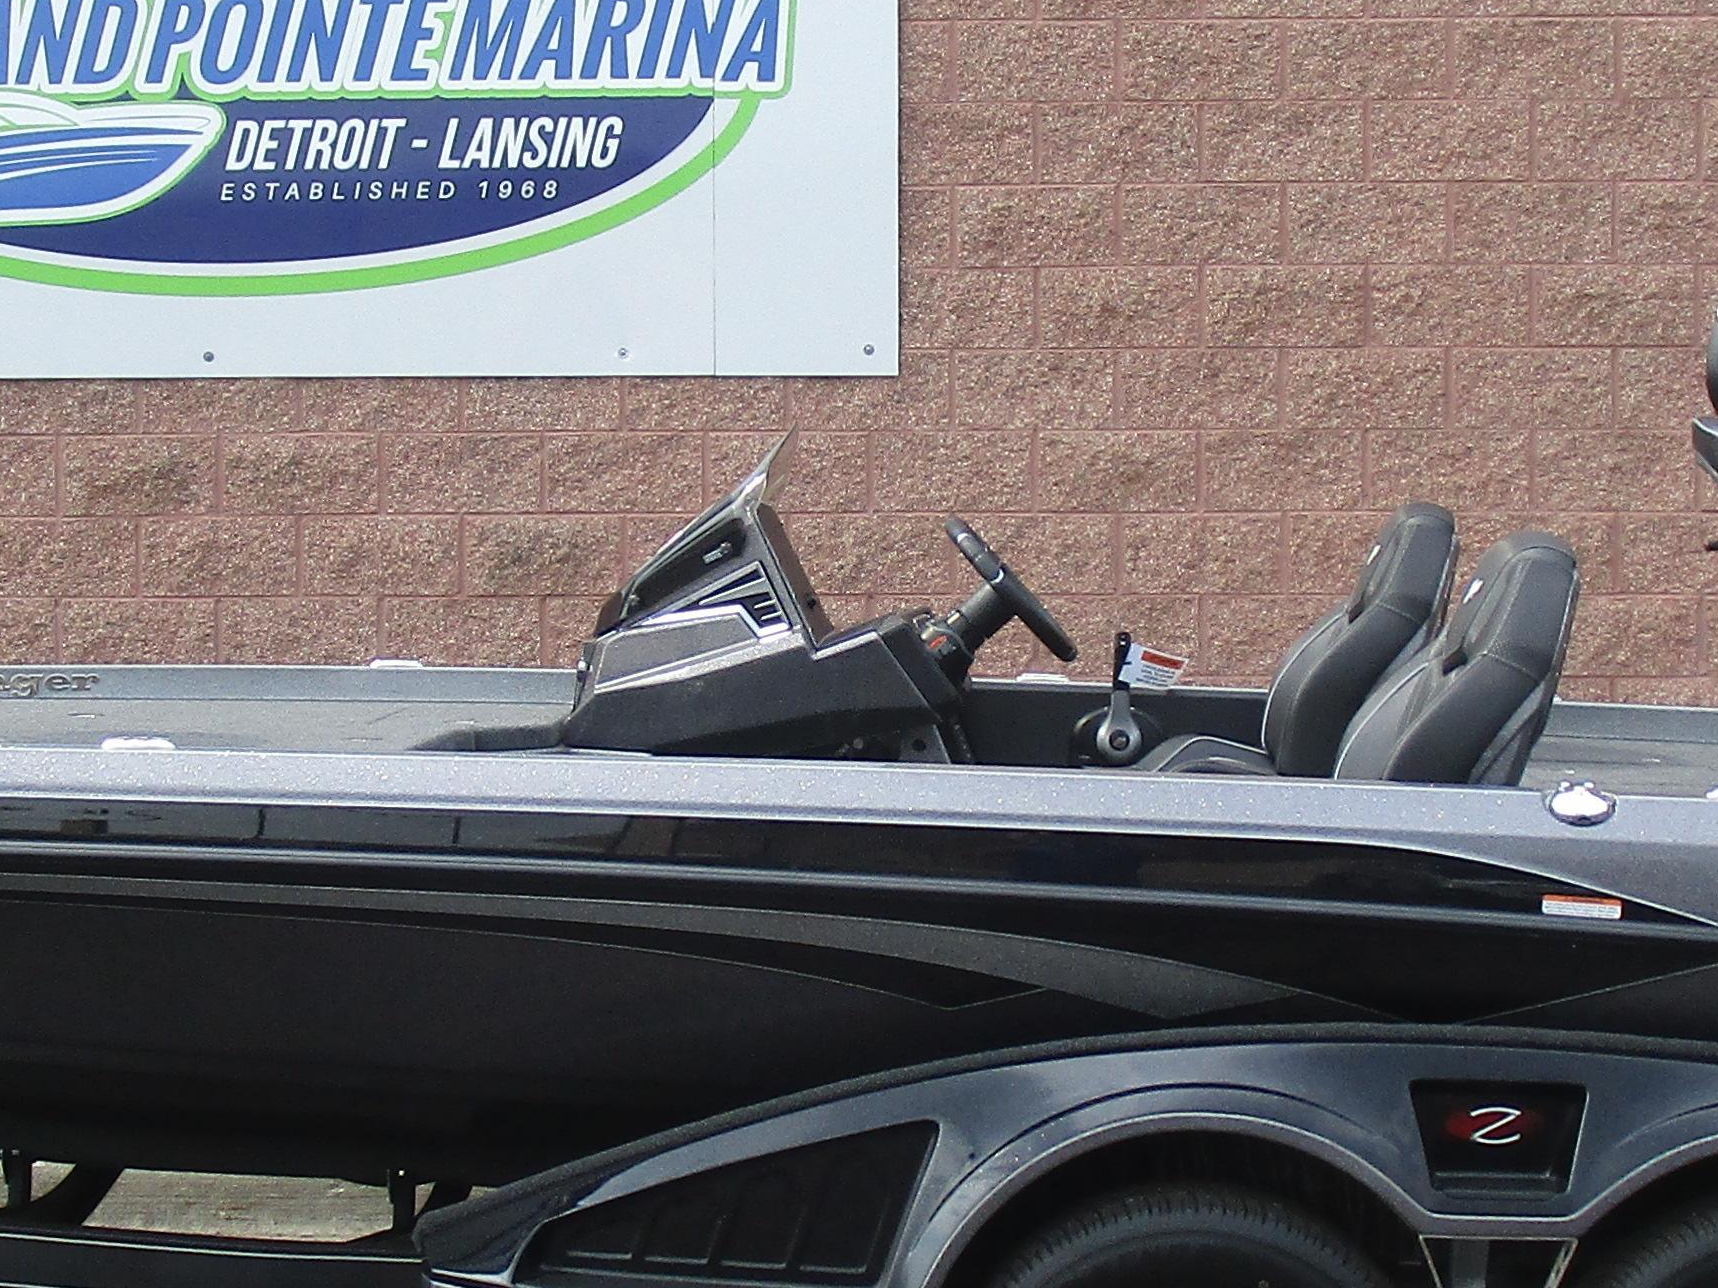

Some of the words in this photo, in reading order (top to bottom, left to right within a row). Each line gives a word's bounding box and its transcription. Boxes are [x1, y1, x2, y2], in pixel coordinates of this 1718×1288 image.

[223, 118, 407, 172] DETROIT
[438, 115, 624, 170] LANSING
[221, 180, 456, 202] ESTABLISHED
[477, 178, 559, 200] 1968
